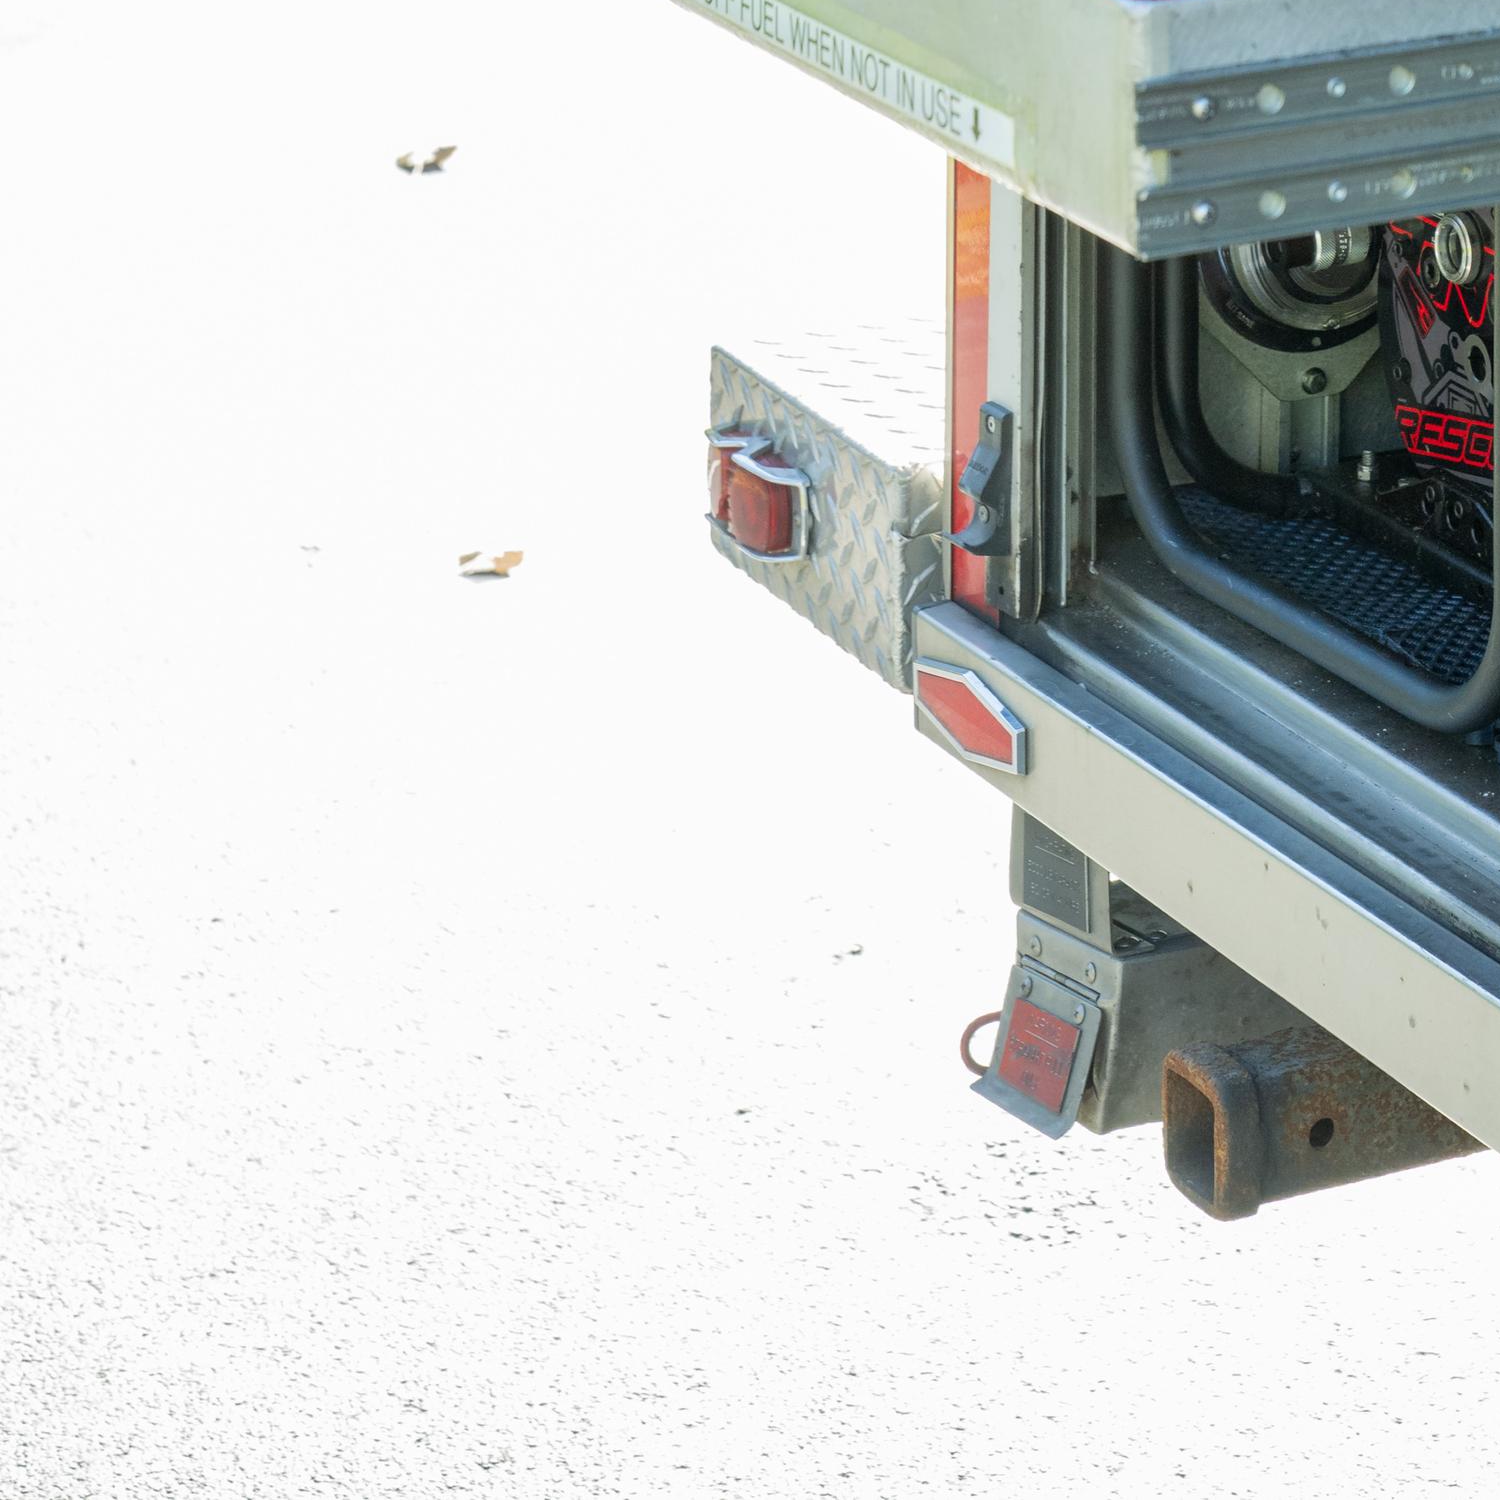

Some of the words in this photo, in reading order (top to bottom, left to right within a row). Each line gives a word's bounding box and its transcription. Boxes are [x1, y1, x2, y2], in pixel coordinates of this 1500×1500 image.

[789, 12, 845, 76] WHEN
[850, 45, 891, 98] NOT
[896, 67, 916, 113] IN
[921, 79, 961, 136] USE
